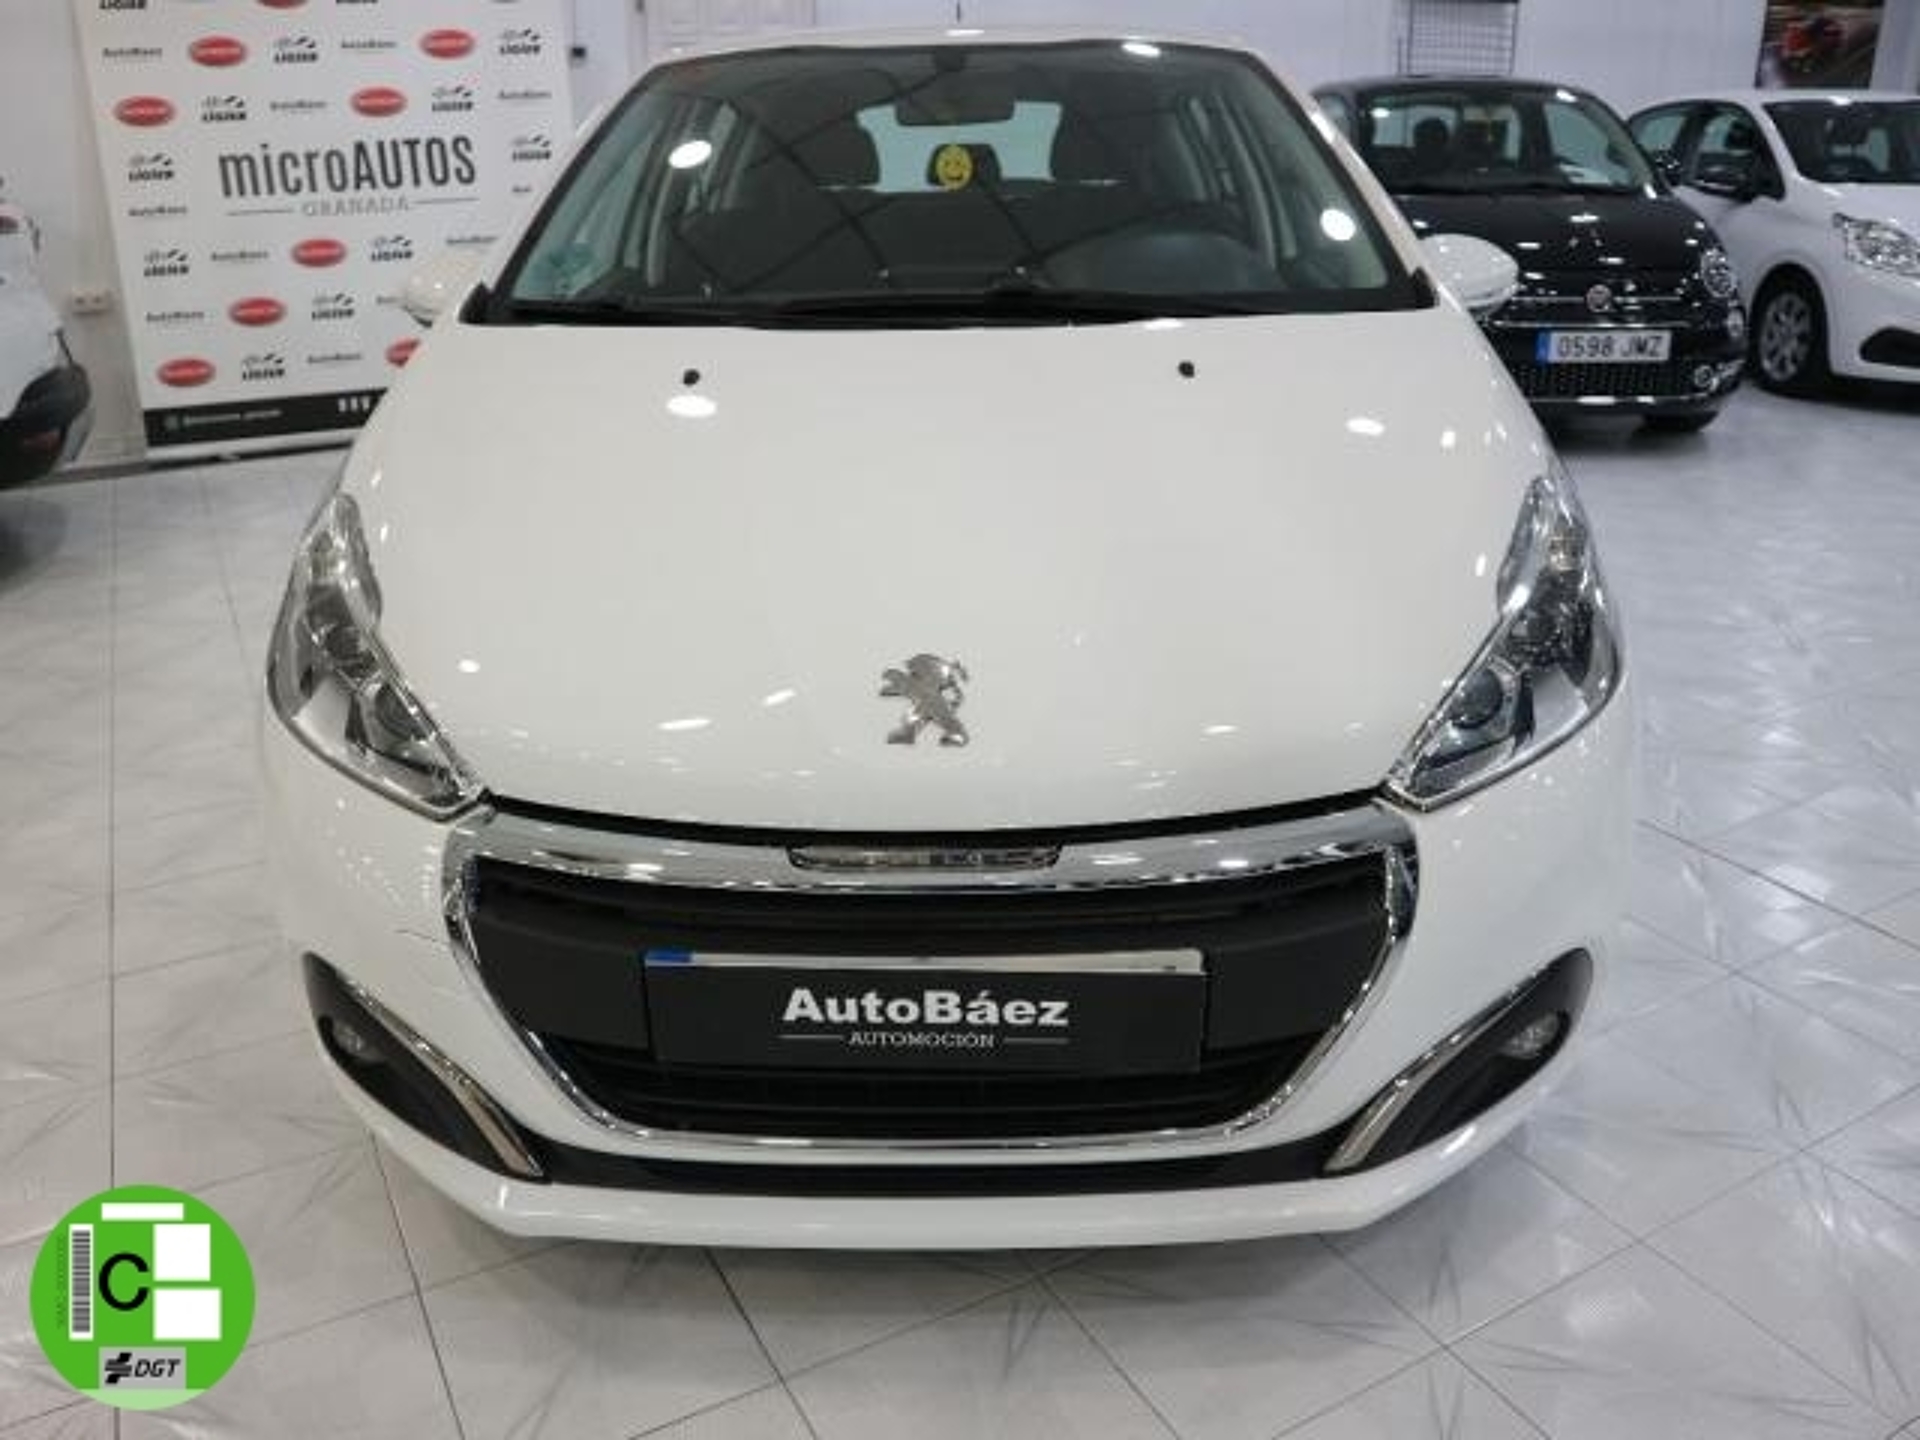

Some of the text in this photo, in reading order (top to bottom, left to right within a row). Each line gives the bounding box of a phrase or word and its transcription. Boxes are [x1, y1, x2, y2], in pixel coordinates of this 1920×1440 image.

[218, 134, 476, 198] microAUTOS
[303, 197, 409, 217] GRANADA
[1557, 334, 1663, 358] 0598 JMZ
[782, 987, 1070, 1027] AutoBáez
